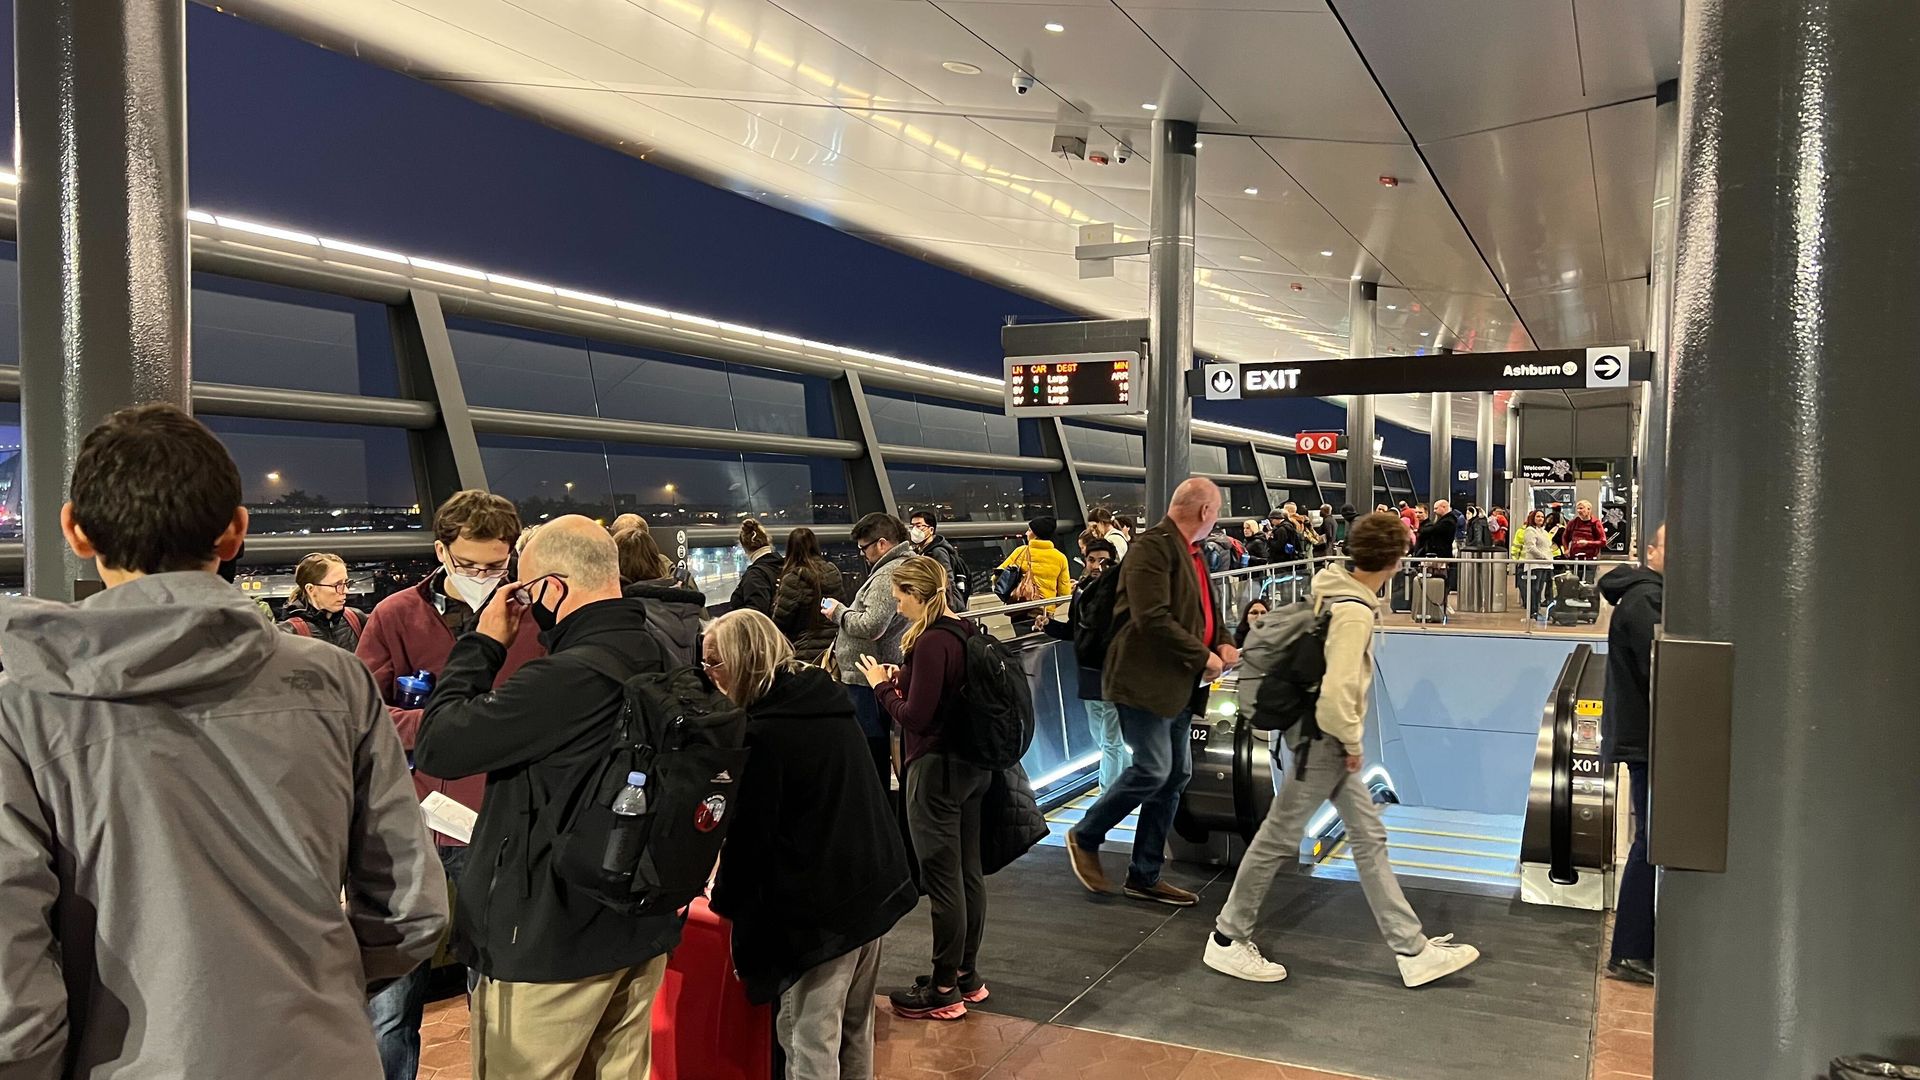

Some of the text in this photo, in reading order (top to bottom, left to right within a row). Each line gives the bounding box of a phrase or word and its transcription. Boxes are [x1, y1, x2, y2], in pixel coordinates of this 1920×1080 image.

[1012, 361, 1129, 374] LN CAR DEST MIN
[1503, 363, 1561, 377] Ashburn
[1110, 371, 1129, 381] ARR
[1246, 368, 1302, 391] EXIT
[1190, 729, 1207, 741] 02
[1571, 758, 1600, 773] X01
